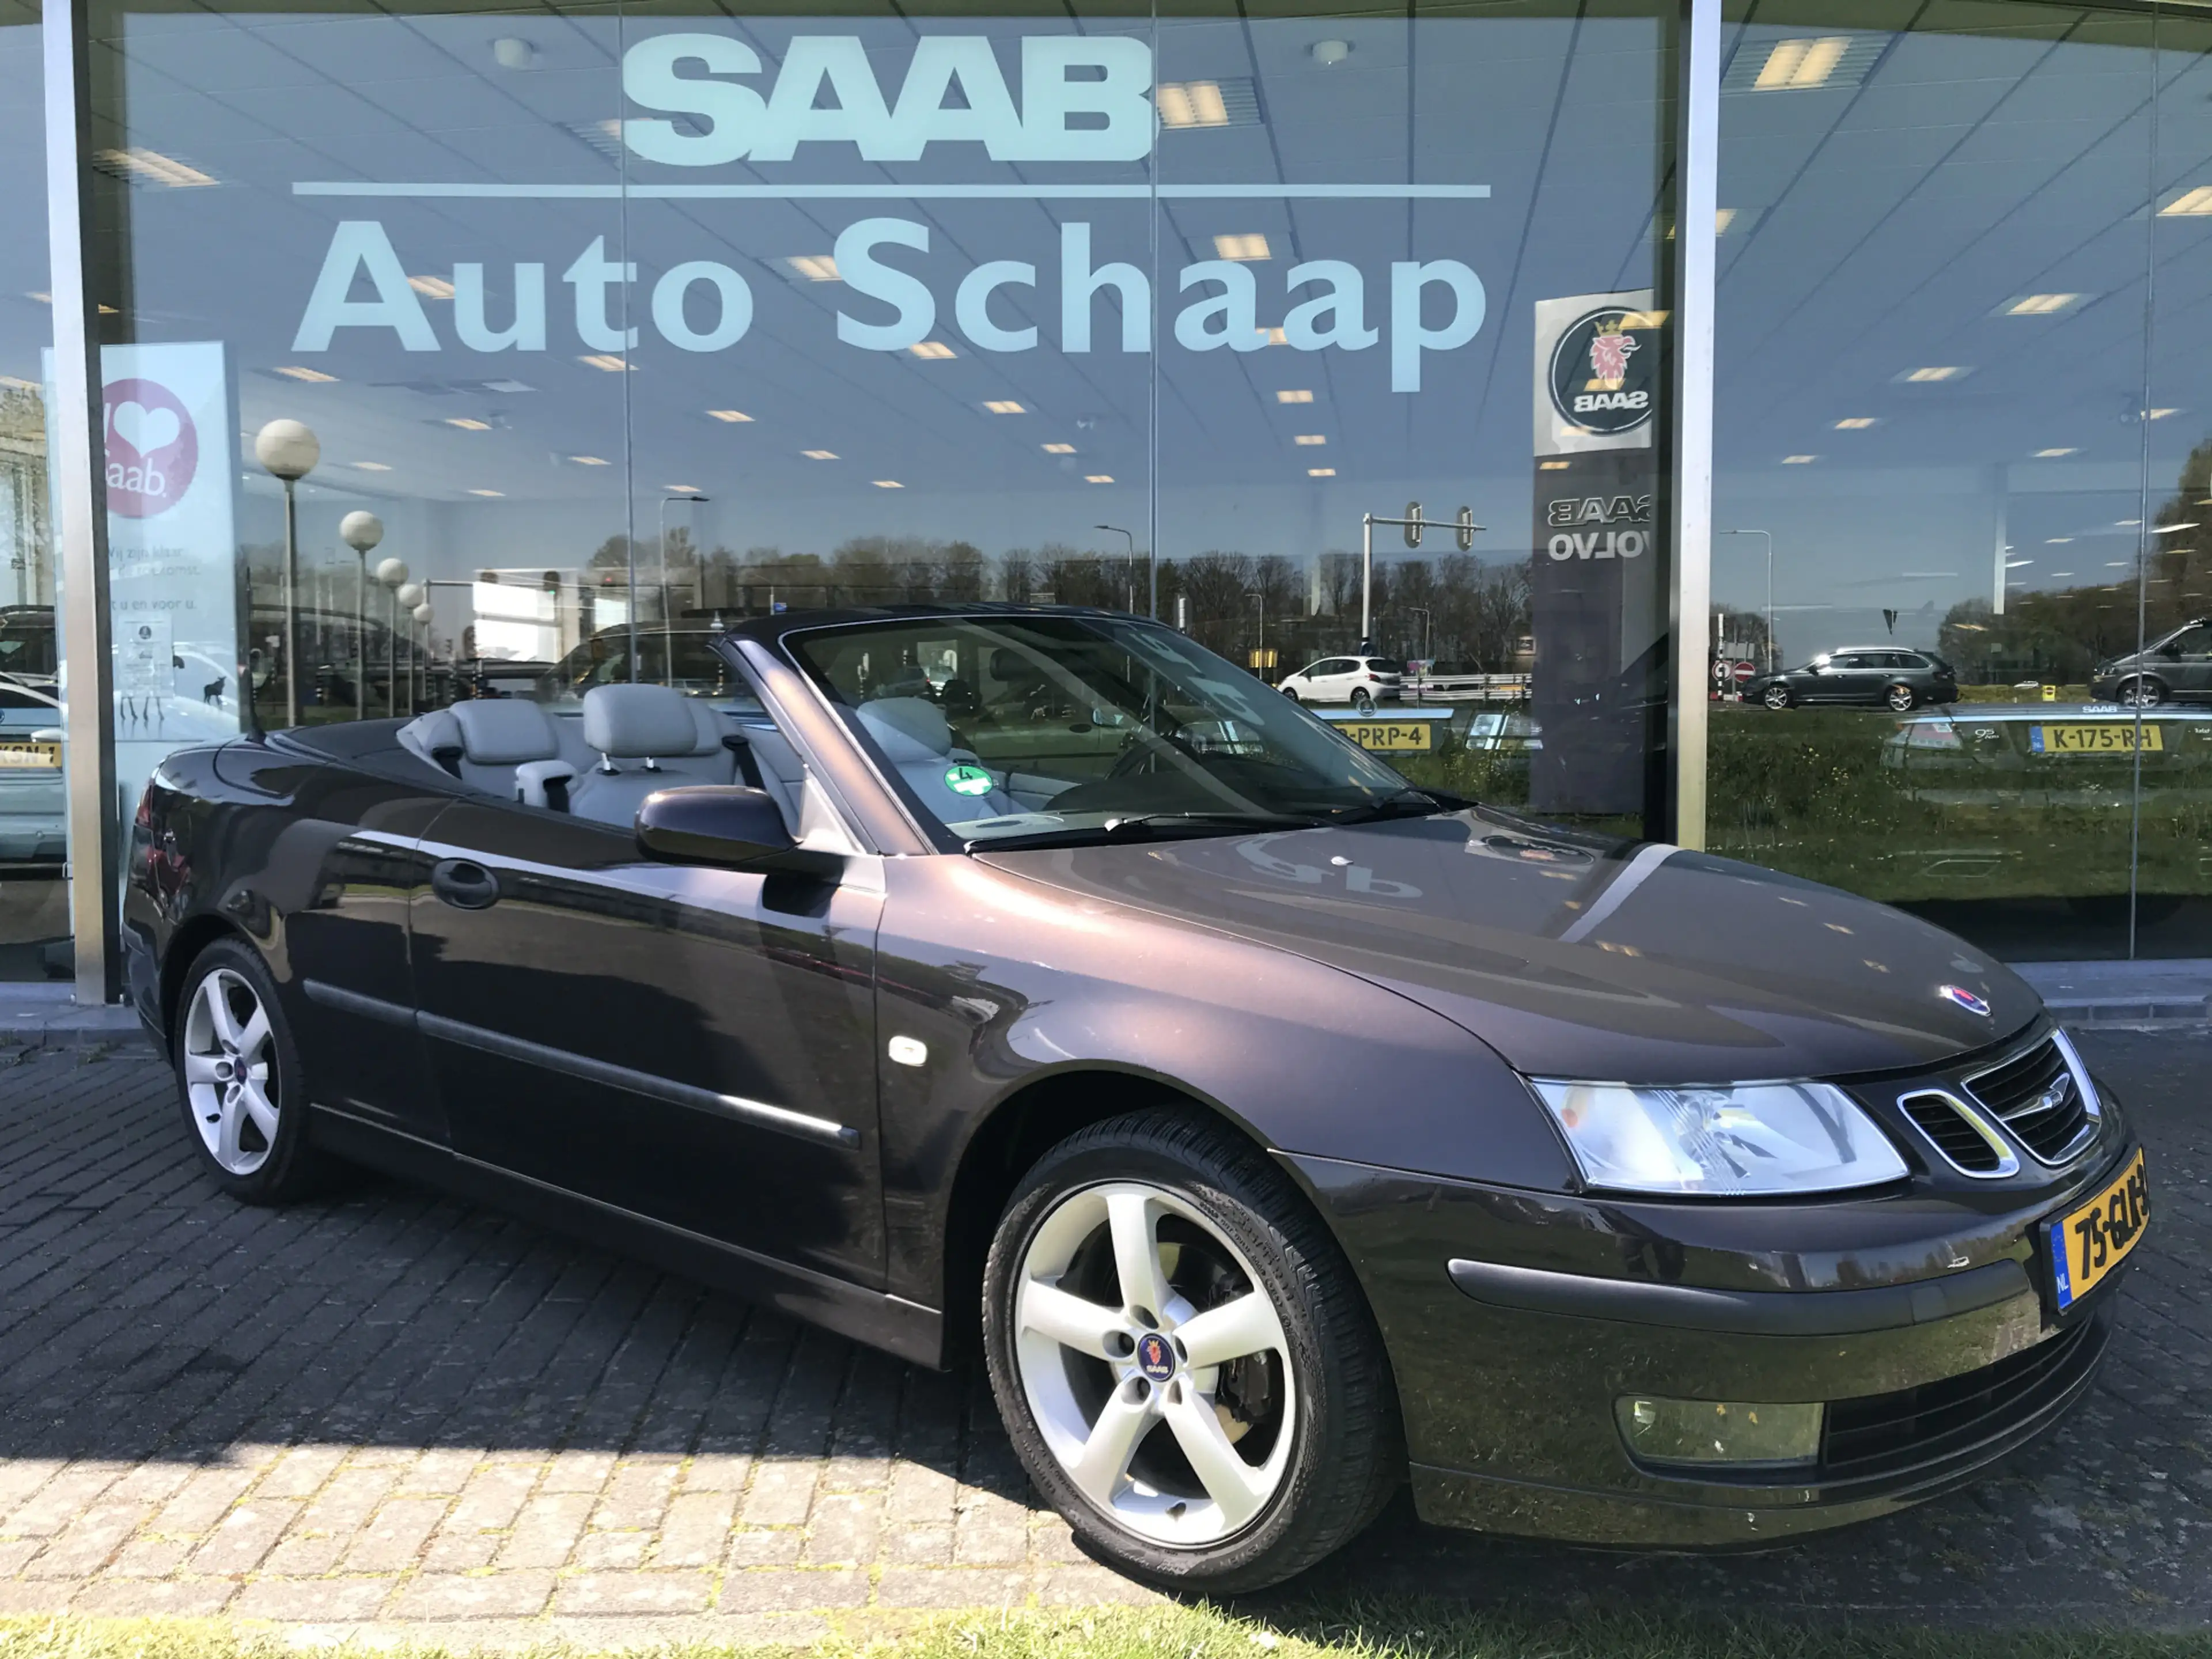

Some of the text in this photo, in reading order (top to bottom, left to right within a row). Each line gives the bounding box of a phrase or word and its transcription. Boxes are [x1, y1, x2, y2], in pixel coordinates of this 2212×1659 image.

[623, 33, 1160, 166] SAAB
[293, 218, 1486, 392] Auto Schaap
[2082, 705, 2117, 713] SAAB
[2054, 729, 2152, 748] K-175-RH
[2056, 1274, 2069, 1294] NL
